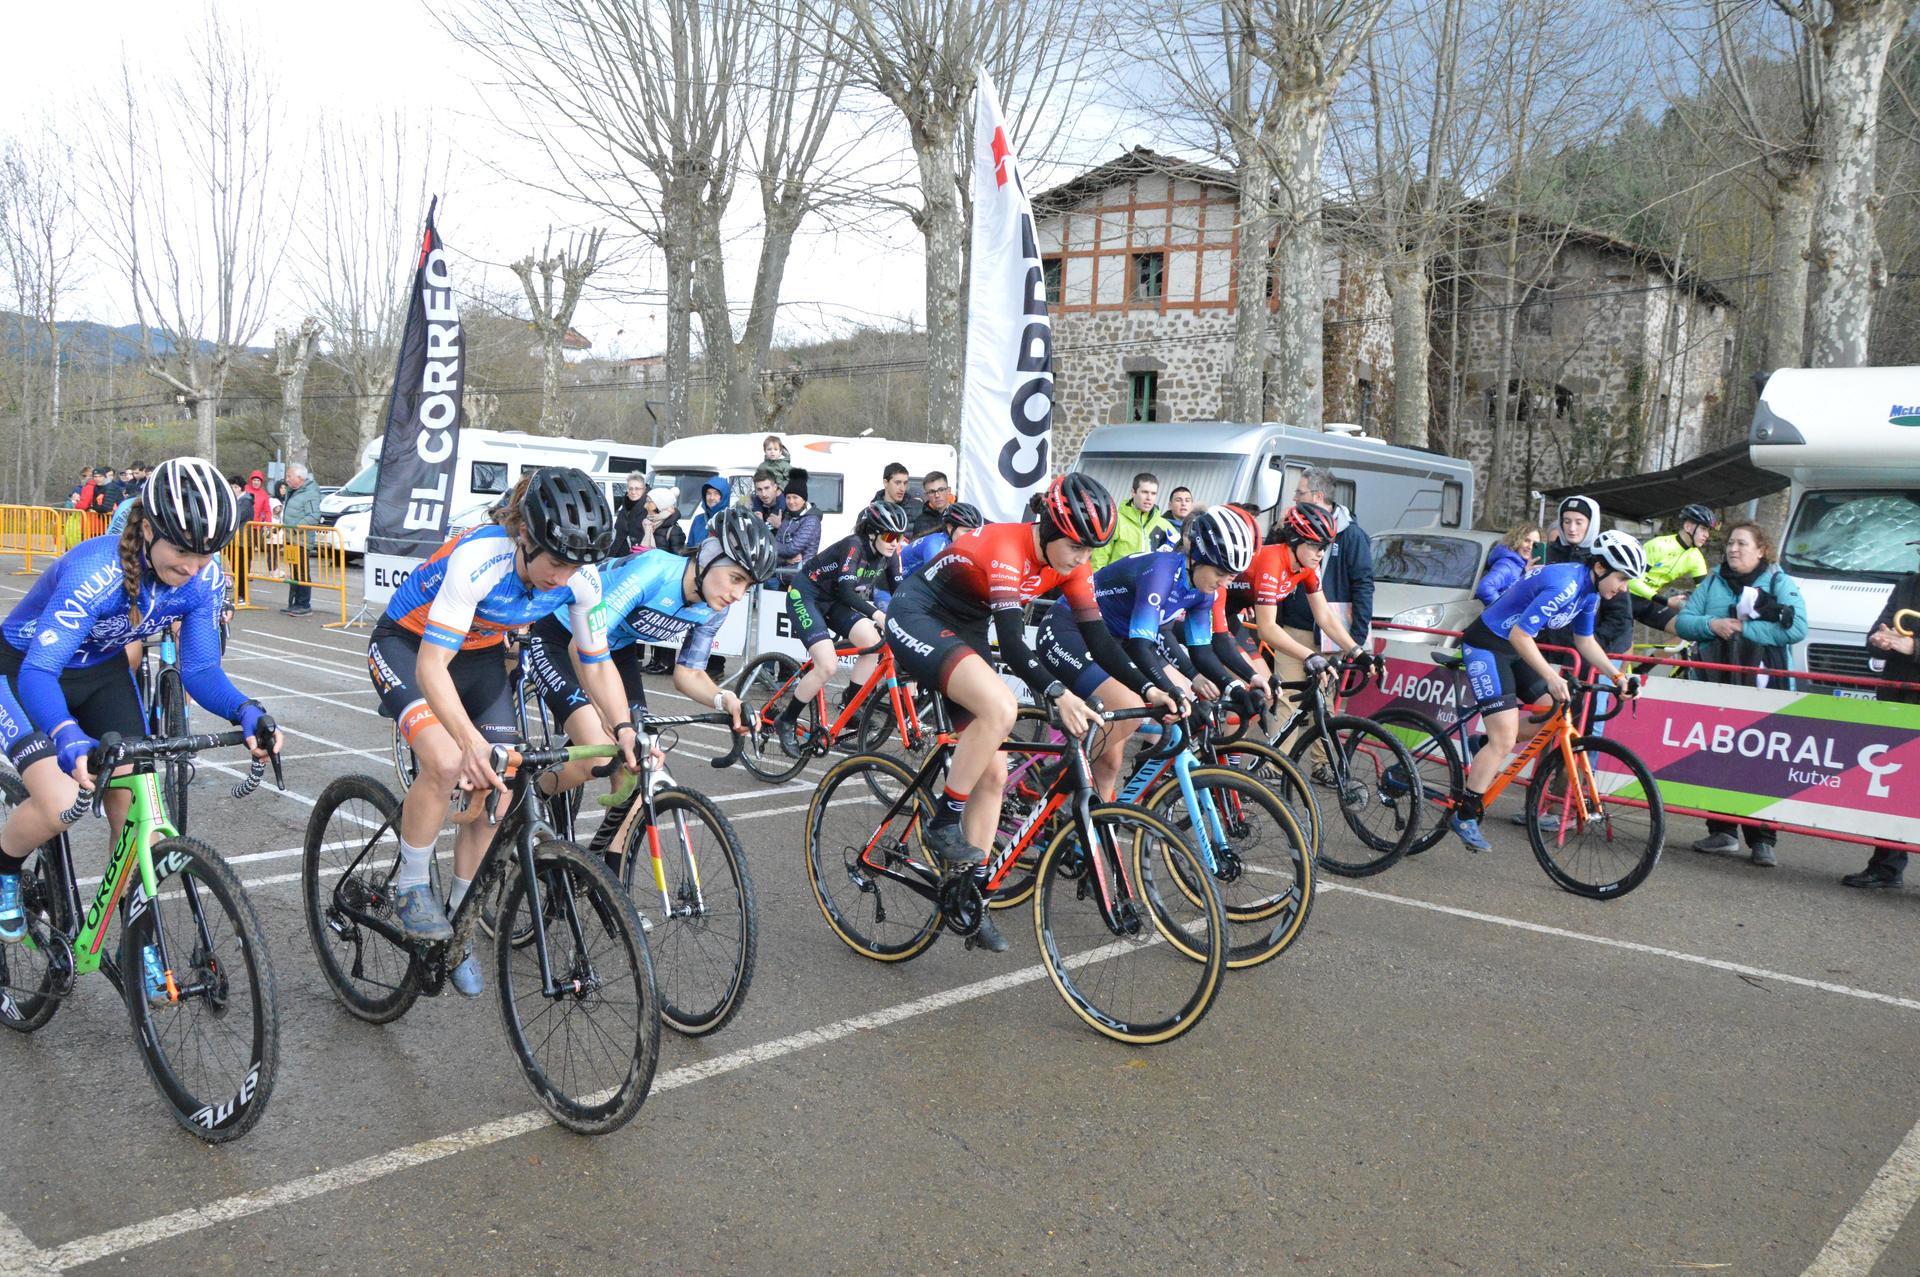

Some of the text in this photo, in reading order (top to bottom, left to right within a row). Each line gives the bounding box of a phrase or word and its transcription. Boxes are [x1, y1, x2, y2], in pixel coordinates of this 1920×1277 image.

[998, 166, 1053, 488] COR
[417, 248, 459, 464] CORREO
[404, 473, 448, 531] EL
[74, 560, 122, 603] NUUK
[375, 568, 390, 587] EL
[580, 567, 600, 594] ALTOKI
[1555, 580, 1578, 604] NUUK
[424, 629, 458, 643] ONOR
[632, 619, 676, 641] ERANDI
[530, 637, 567, 693] CARAVANAS
[1045, 650, 1060, 667] Tech
[1052, 641, 1083, 670] Telefónica
[1380, 672, 1468, 708] LABORAL
[1471, 678, 1484, 700] EULEN
[1437, 708, 1458, 723] kutx
[1247, 709, 1304, 770] OBEA
[1503, 728, 1553, 776] CANYON
[1662, 718, 1844, 769] LABORAL
[1117, 758, 1164, 802] NYON
[1788, 767, 1841, 788] kutxa
[87, 819, 134, 930] ORBEA
[129, 851, 189, 918] ELTE
